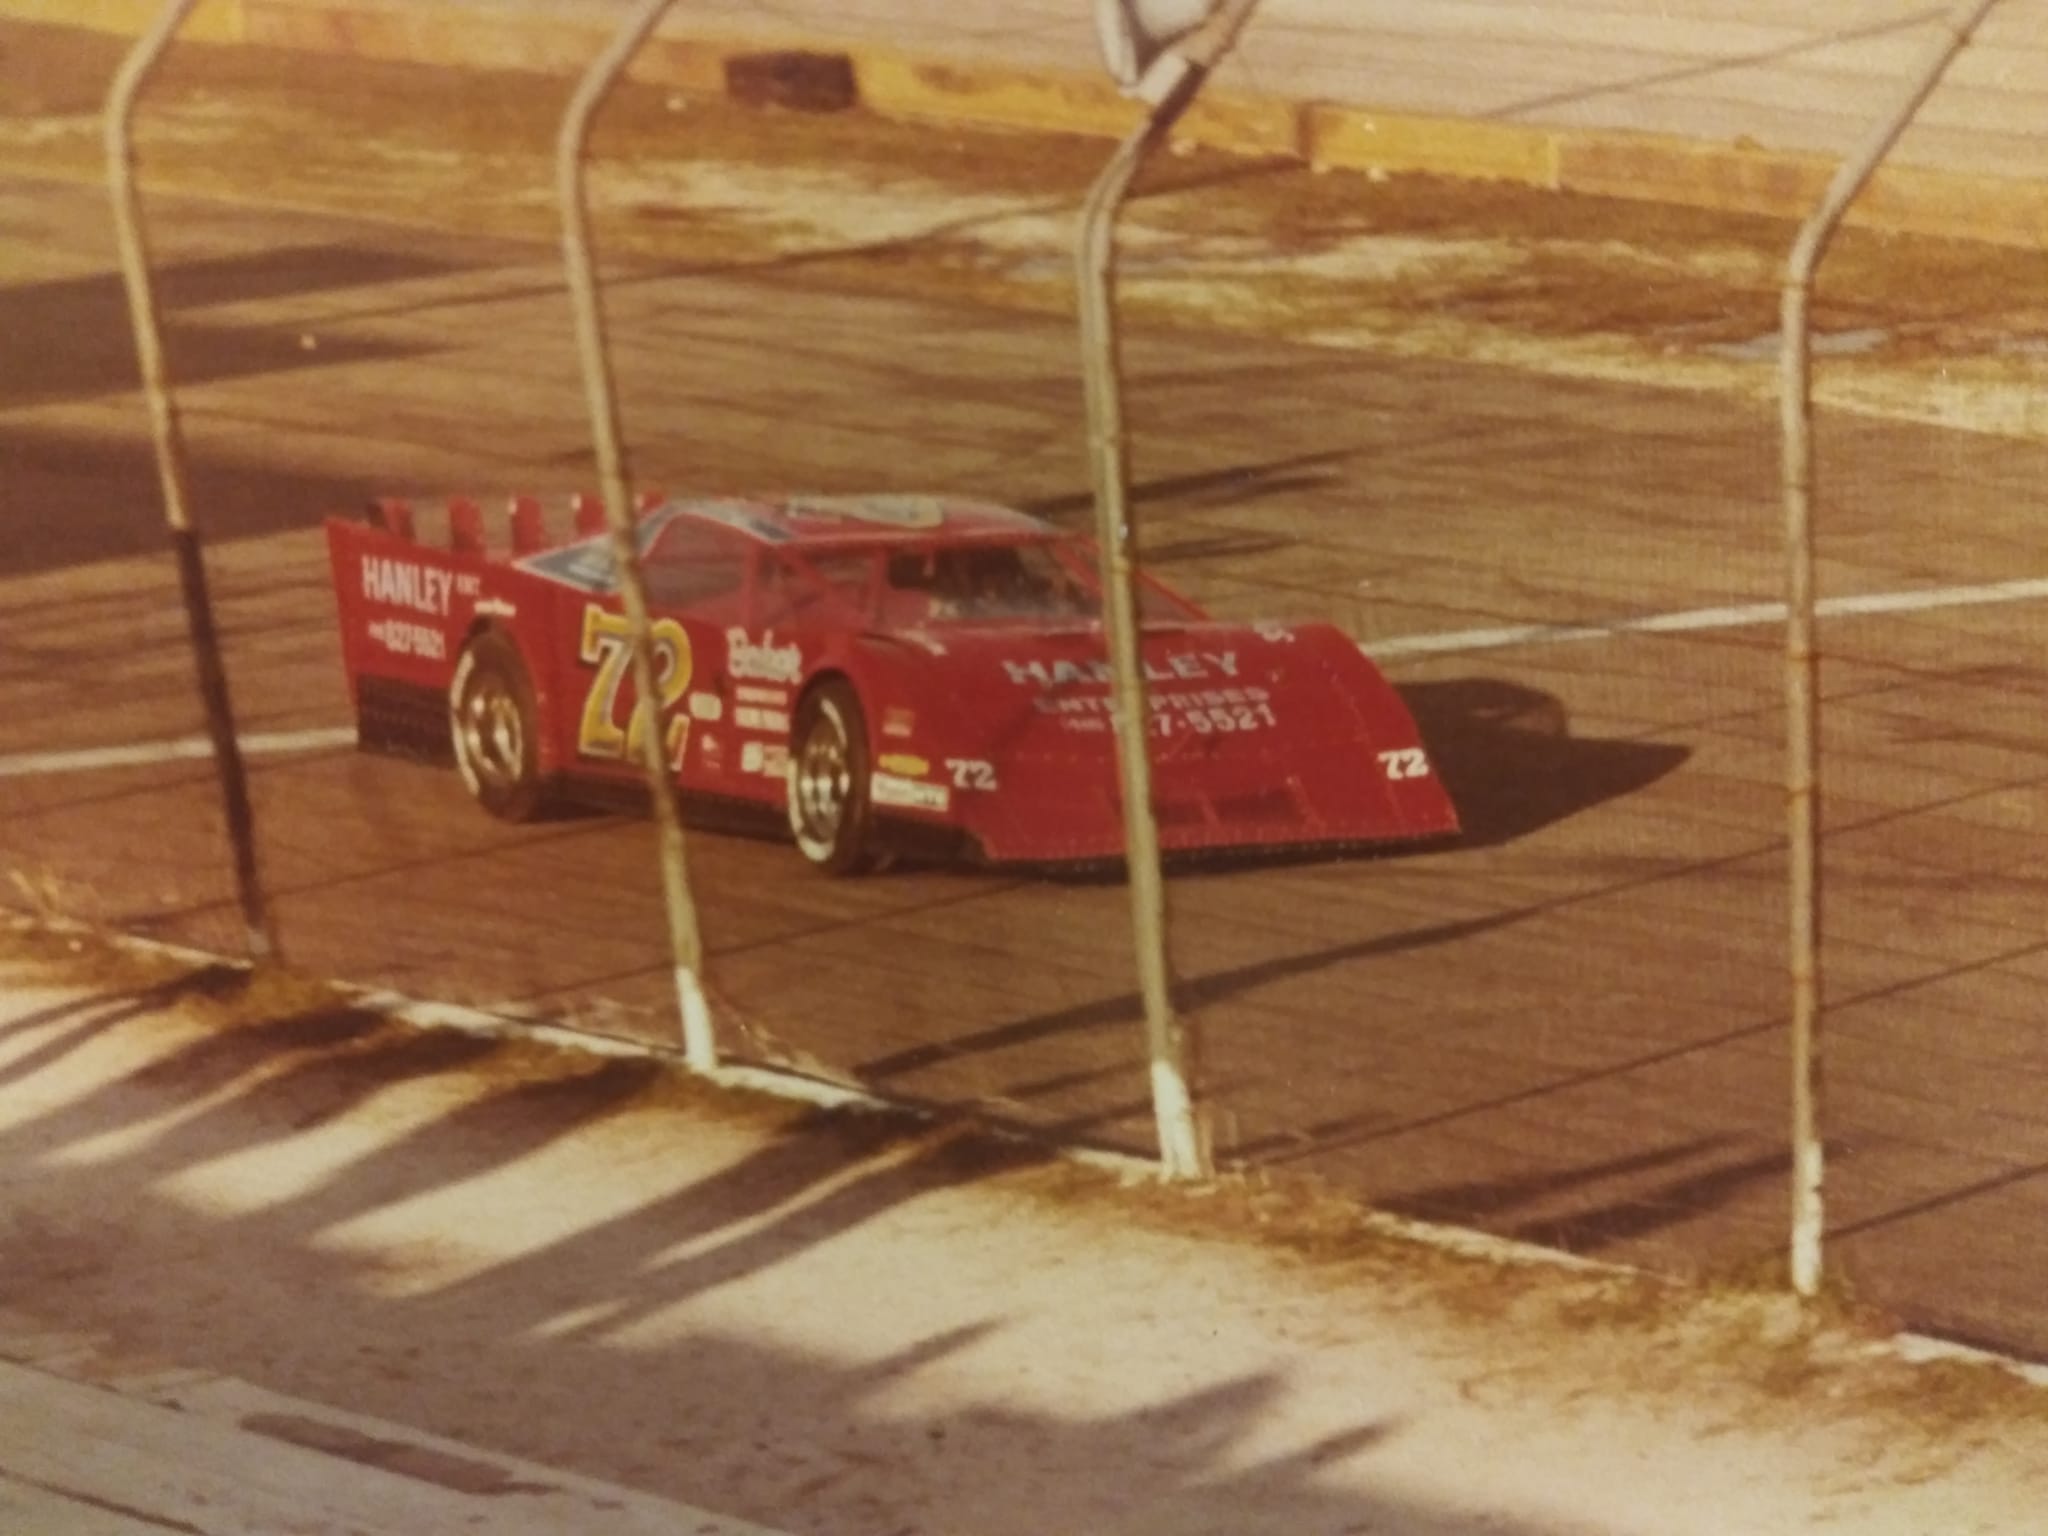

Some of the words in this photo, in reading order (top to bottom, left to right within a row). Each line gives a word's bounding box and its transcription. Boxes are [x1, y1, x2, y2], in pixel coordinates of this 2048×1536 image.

[361, 554, 452, 617] HANLEY
[577, 602, 693, 773] 72
[945, 758, 998, 791] 72
[1378, 748, 1429, 779] 72
